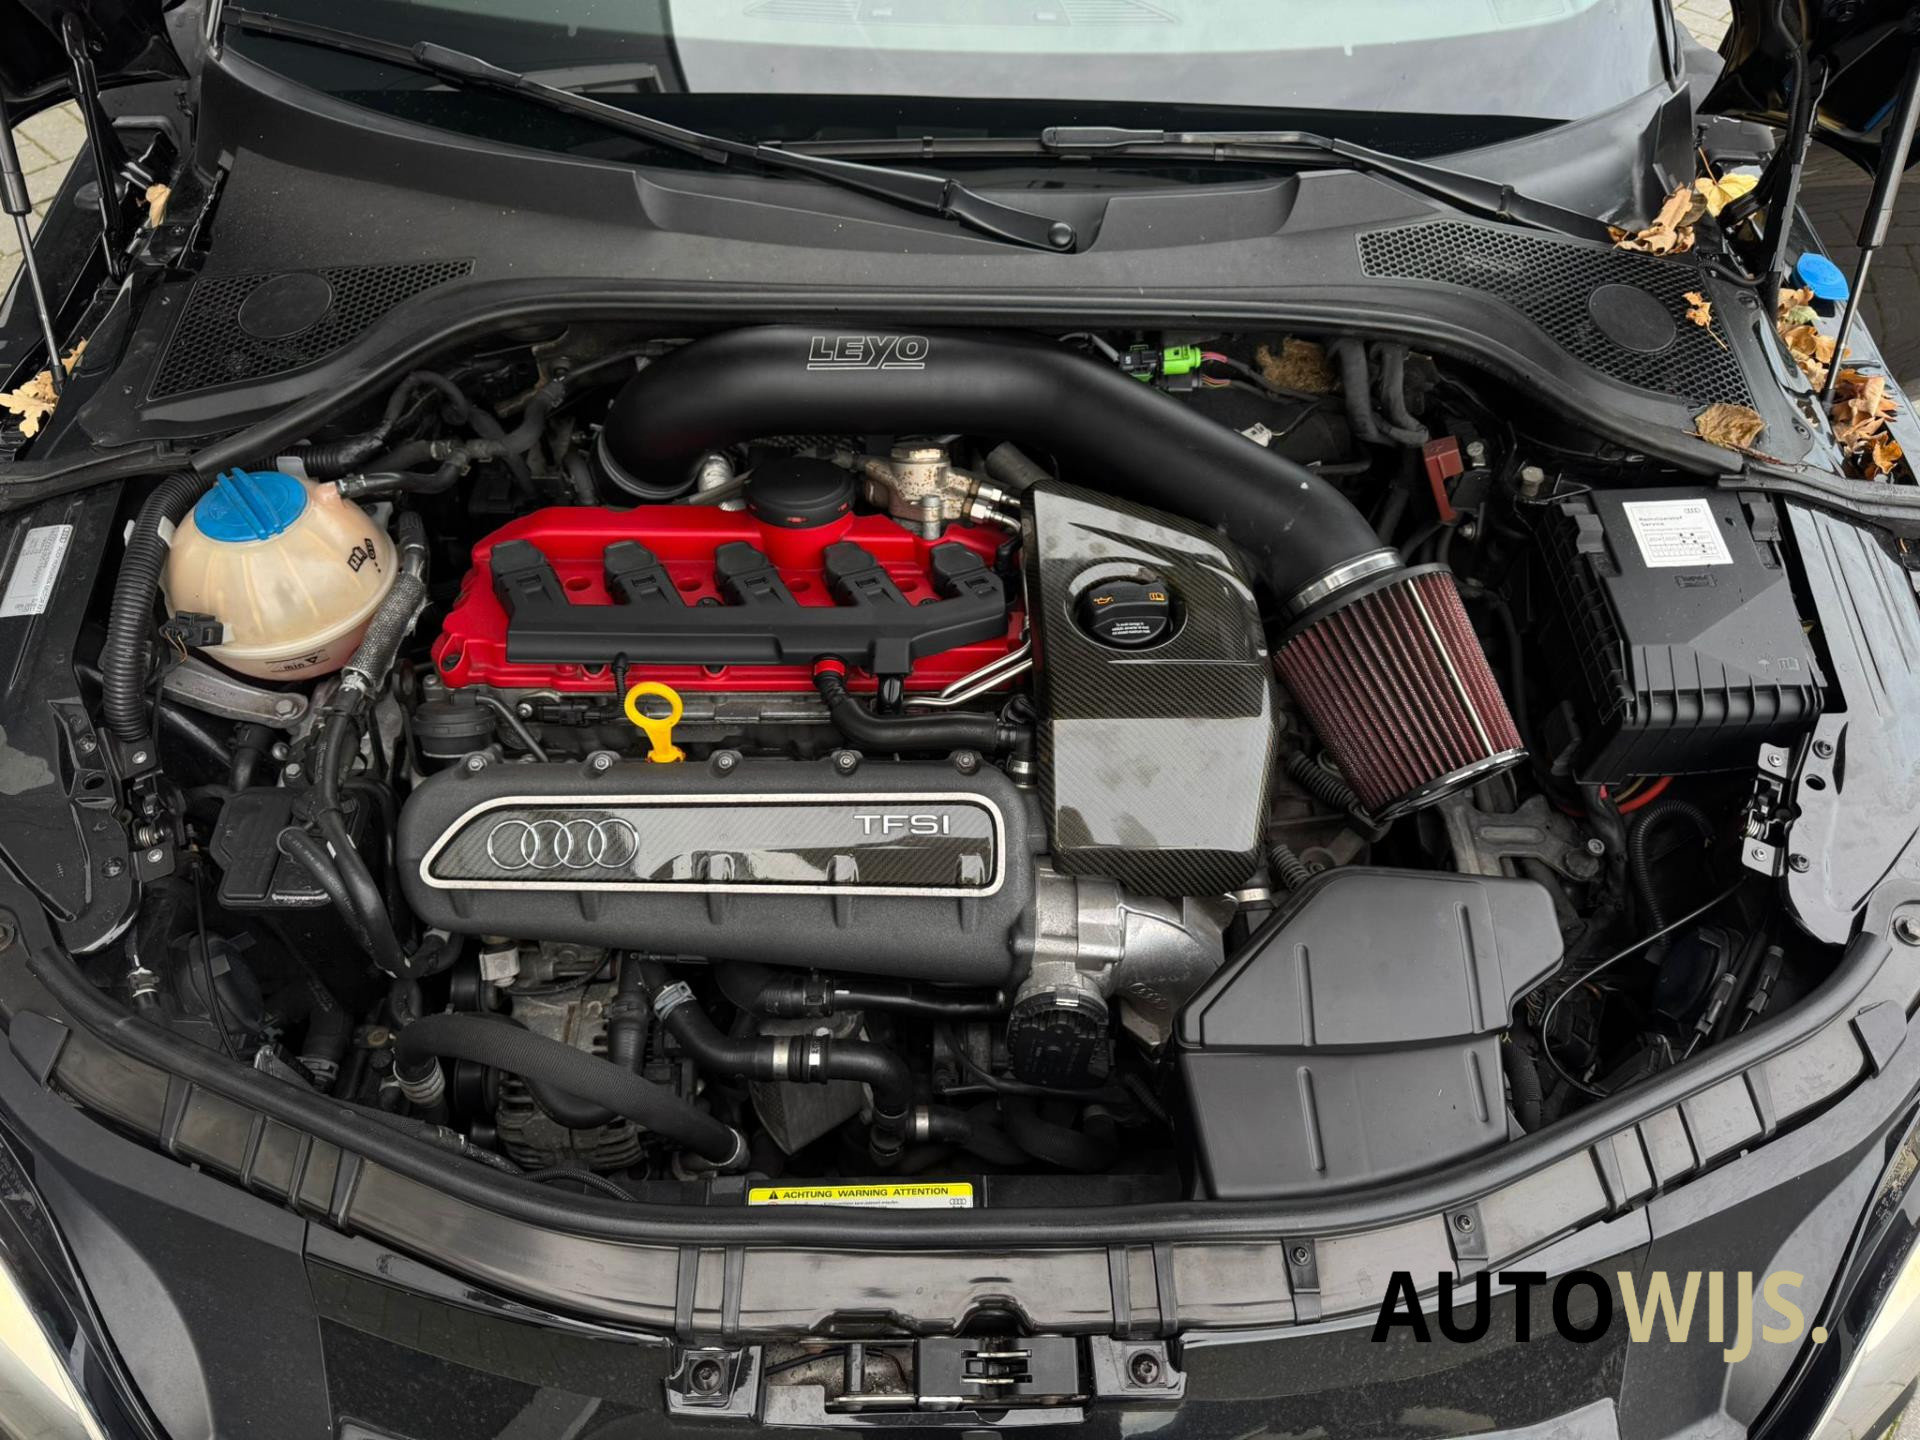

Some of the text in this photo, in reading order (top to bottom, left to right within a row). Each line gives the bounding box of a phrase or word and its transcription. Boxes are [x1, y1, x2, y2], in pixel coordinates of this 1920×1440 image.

[807, 335, 930, 370] LEYO
[284, 663, 304, 671] min
[853, 814, 950, 835] TFSI
[783, 1187, 949, 1199] ACHTUNG WARNING ATTENTION
